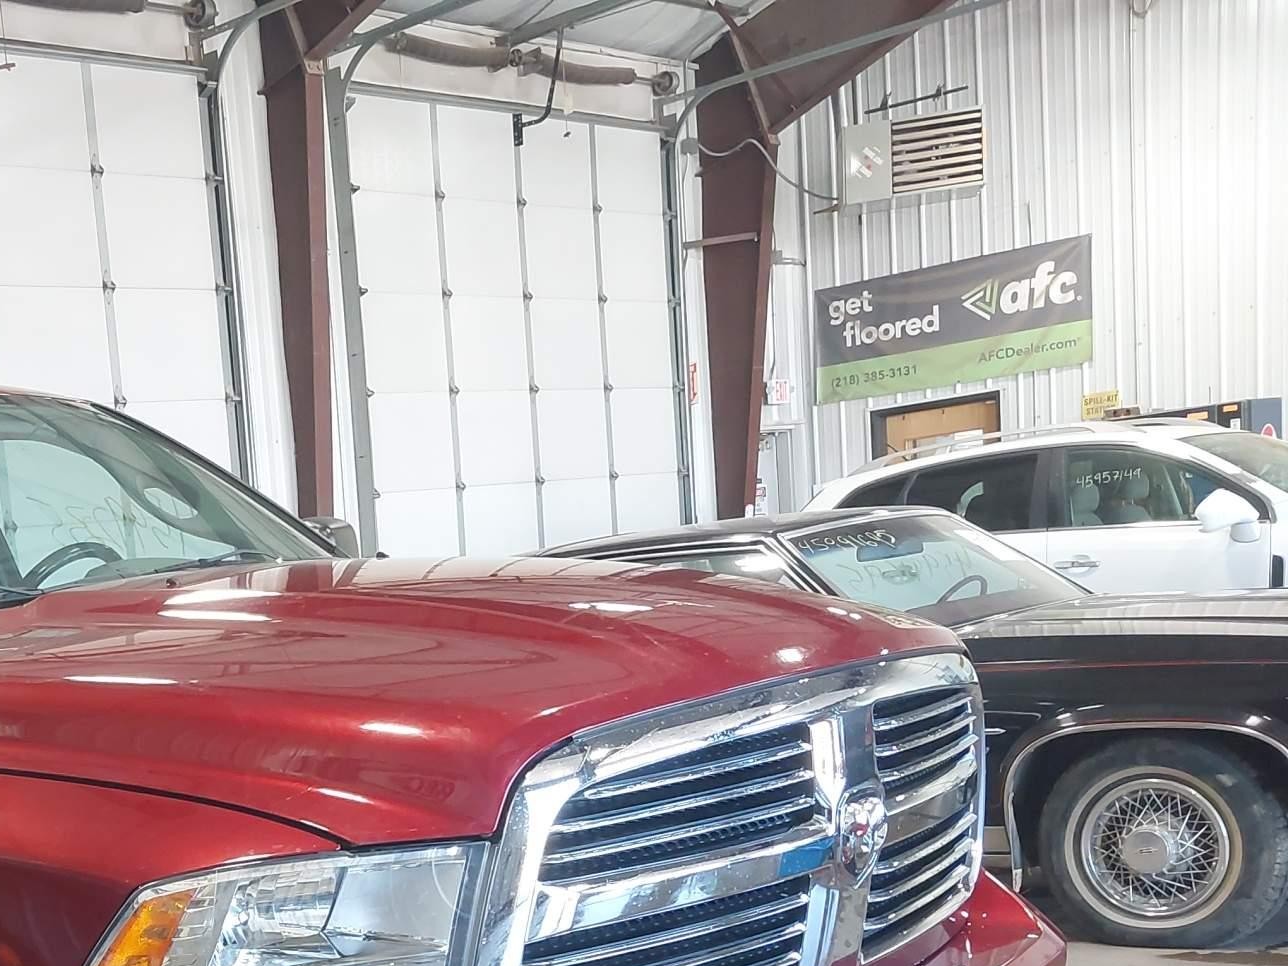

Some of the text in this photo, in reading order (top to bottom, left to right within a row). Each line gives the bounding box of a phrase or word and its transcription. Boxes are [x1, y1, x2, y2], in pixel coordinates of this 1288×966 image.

[828, 290, 873, 325] get
[843, 304, 940, 347] floored
[977, 338, 1078, 364] AFCDealer.com
[831, 364, 917, 389] (218) 385-3131
